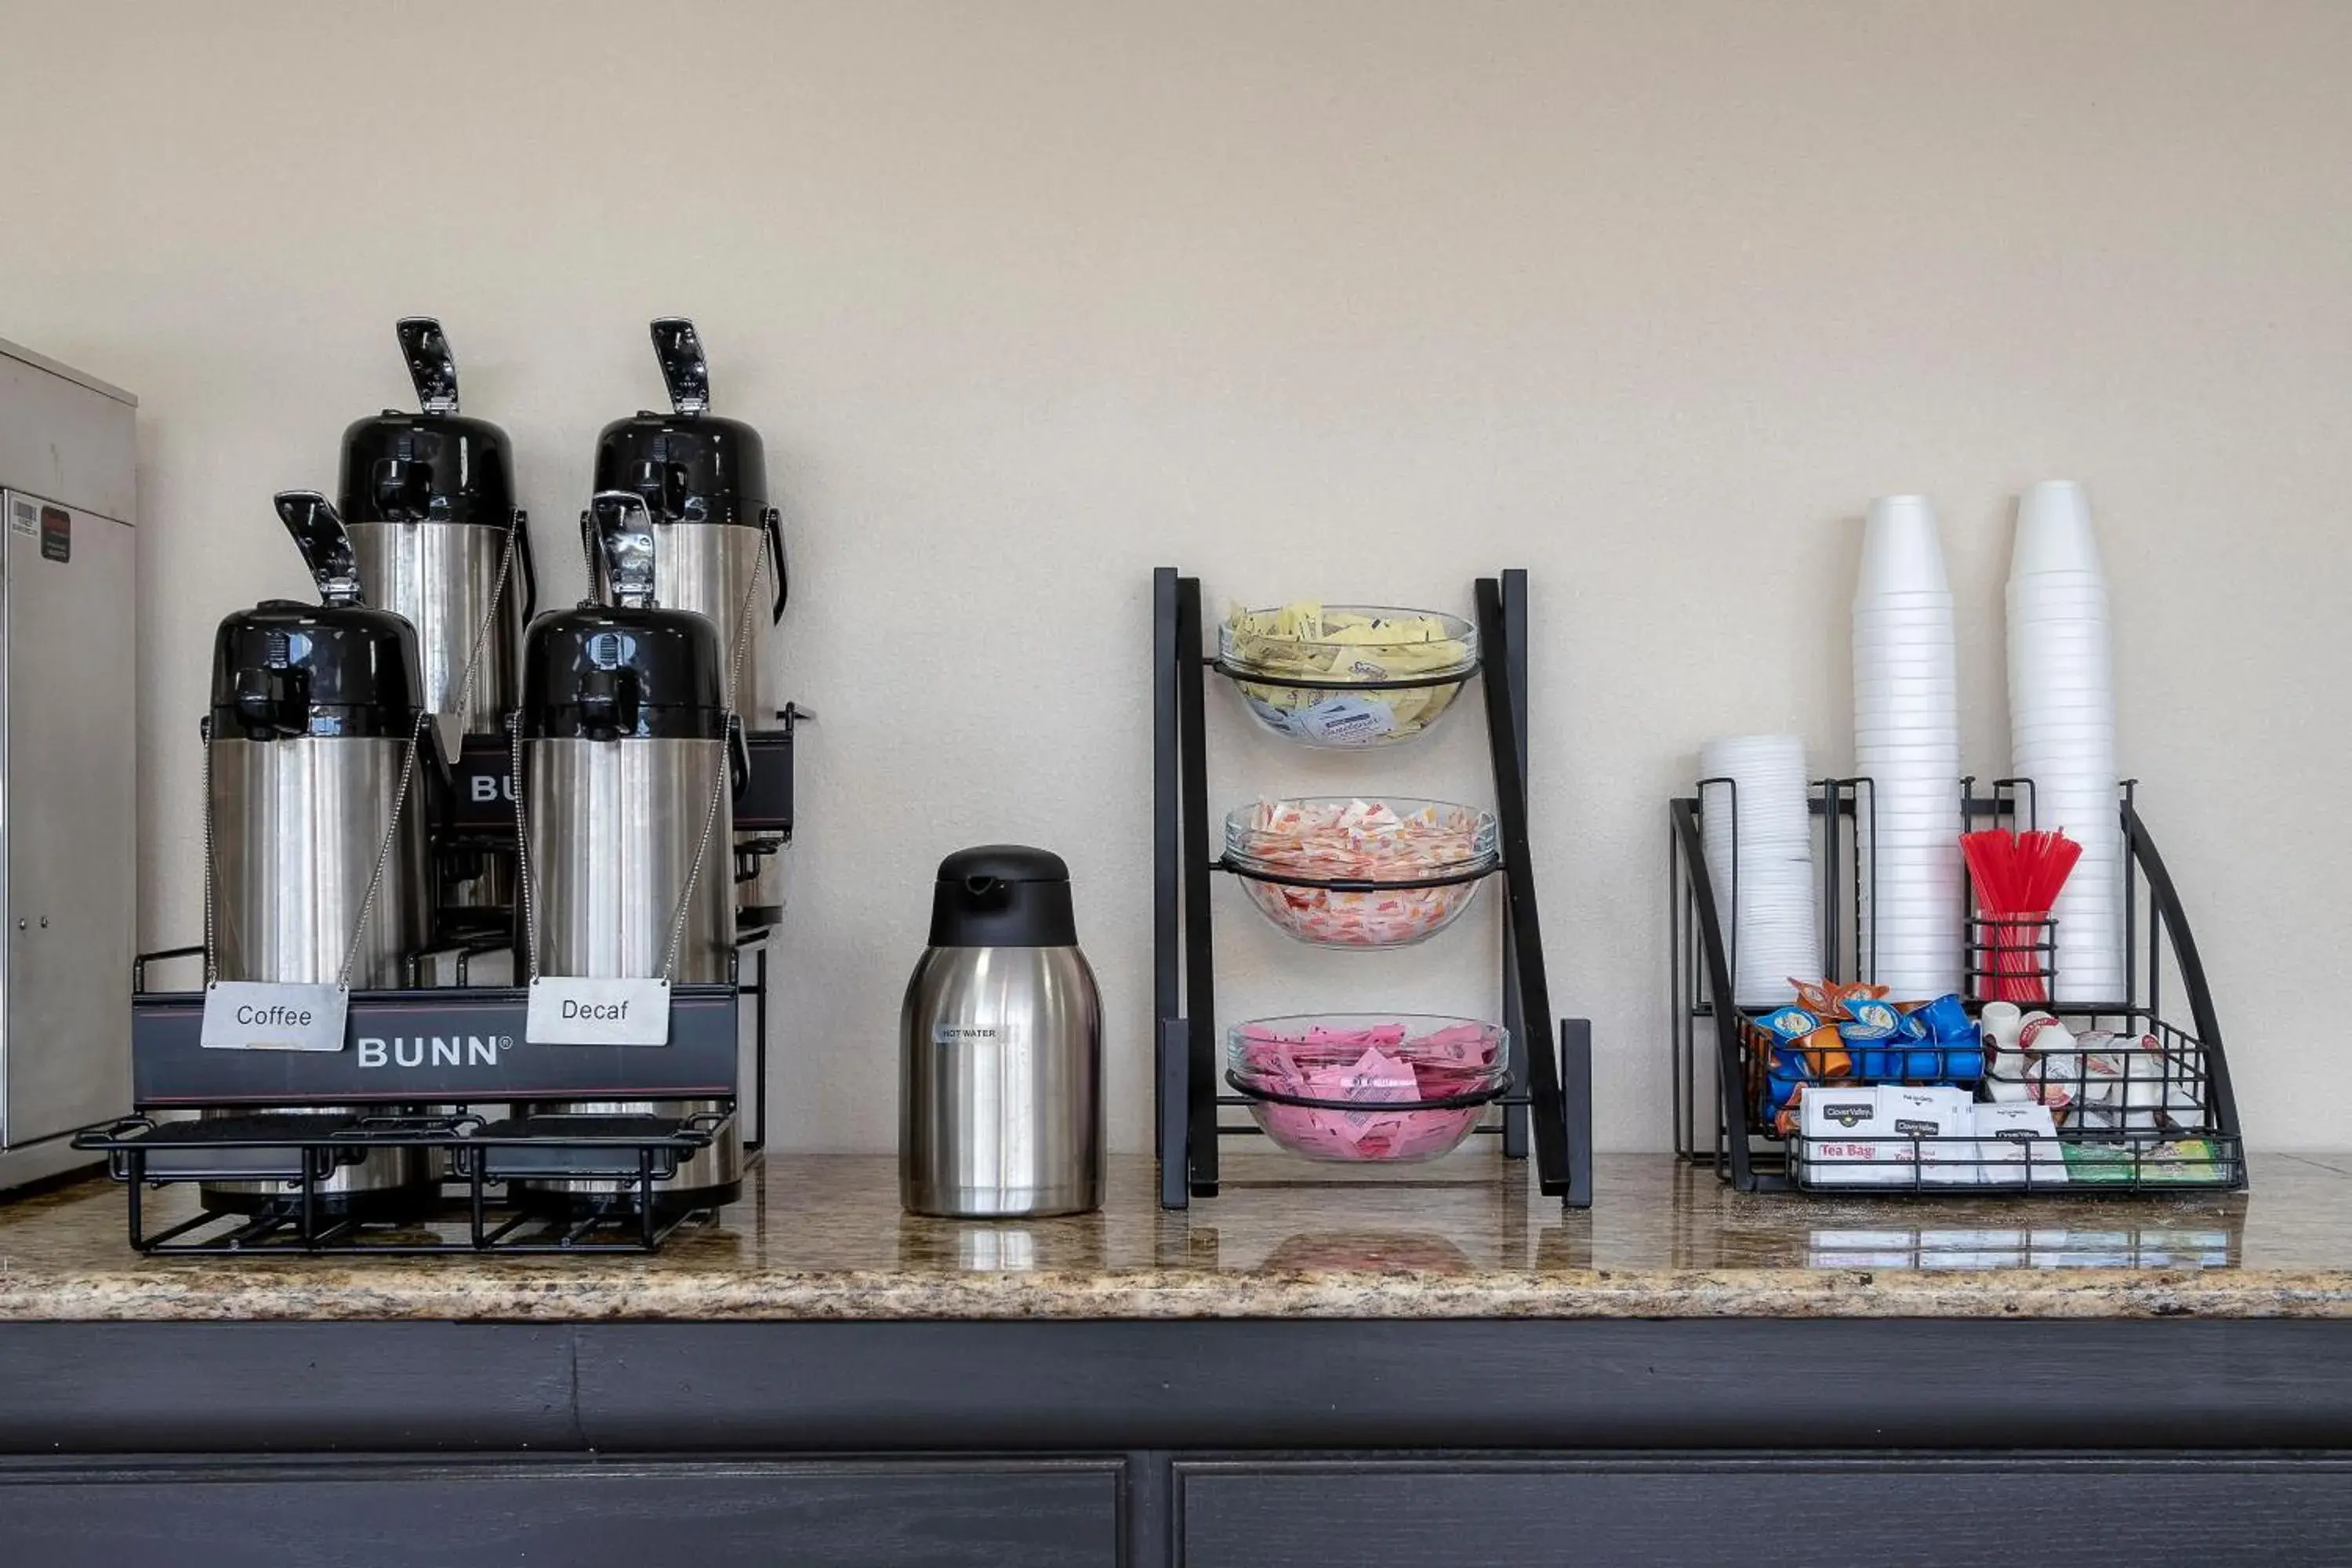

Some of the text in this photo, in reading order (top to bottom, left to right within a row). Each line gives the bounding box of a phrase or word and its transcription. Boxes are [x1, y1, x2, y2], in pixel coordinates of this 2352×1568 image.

[471, 775, 516, 801] BU
[237, 1005, 311, 1026] Coffee
[562, 999, 629, 1020] Decaf
[1820, 1144, 1843, 1156] Tea
